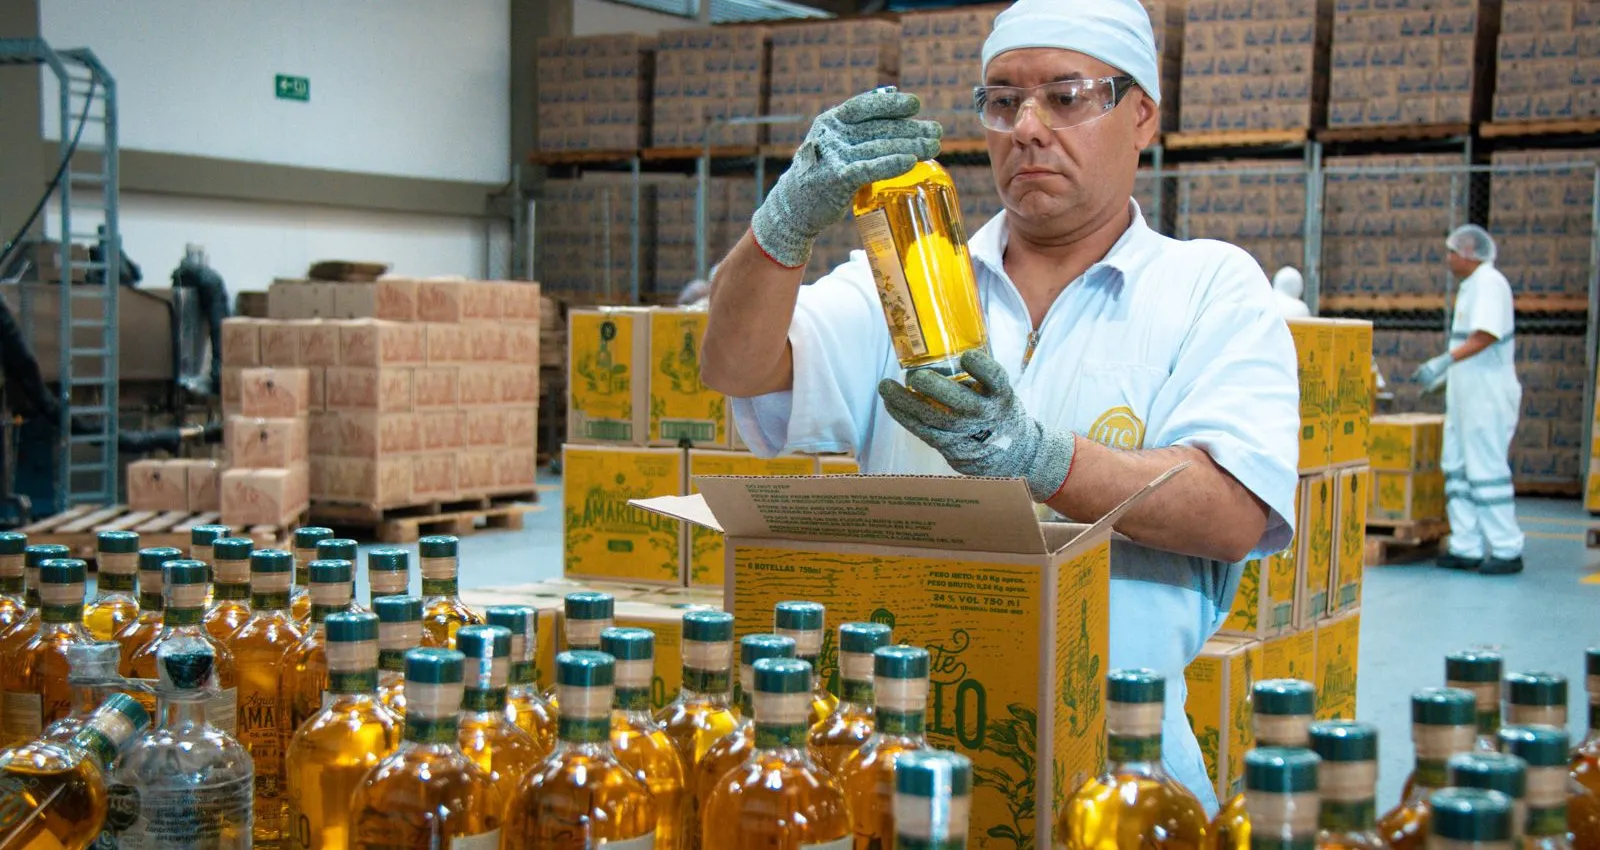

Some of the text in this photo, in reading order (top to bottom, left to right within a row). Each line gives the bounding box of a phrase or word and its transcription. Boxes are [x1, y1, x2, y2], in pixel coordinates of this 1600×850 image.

[754, 563, 795, 572] BOTELLAS
[933, 593, 945, 601] 24
[959, 596, 980, 604] VOL
[983, 597, 1004, 605] 750
